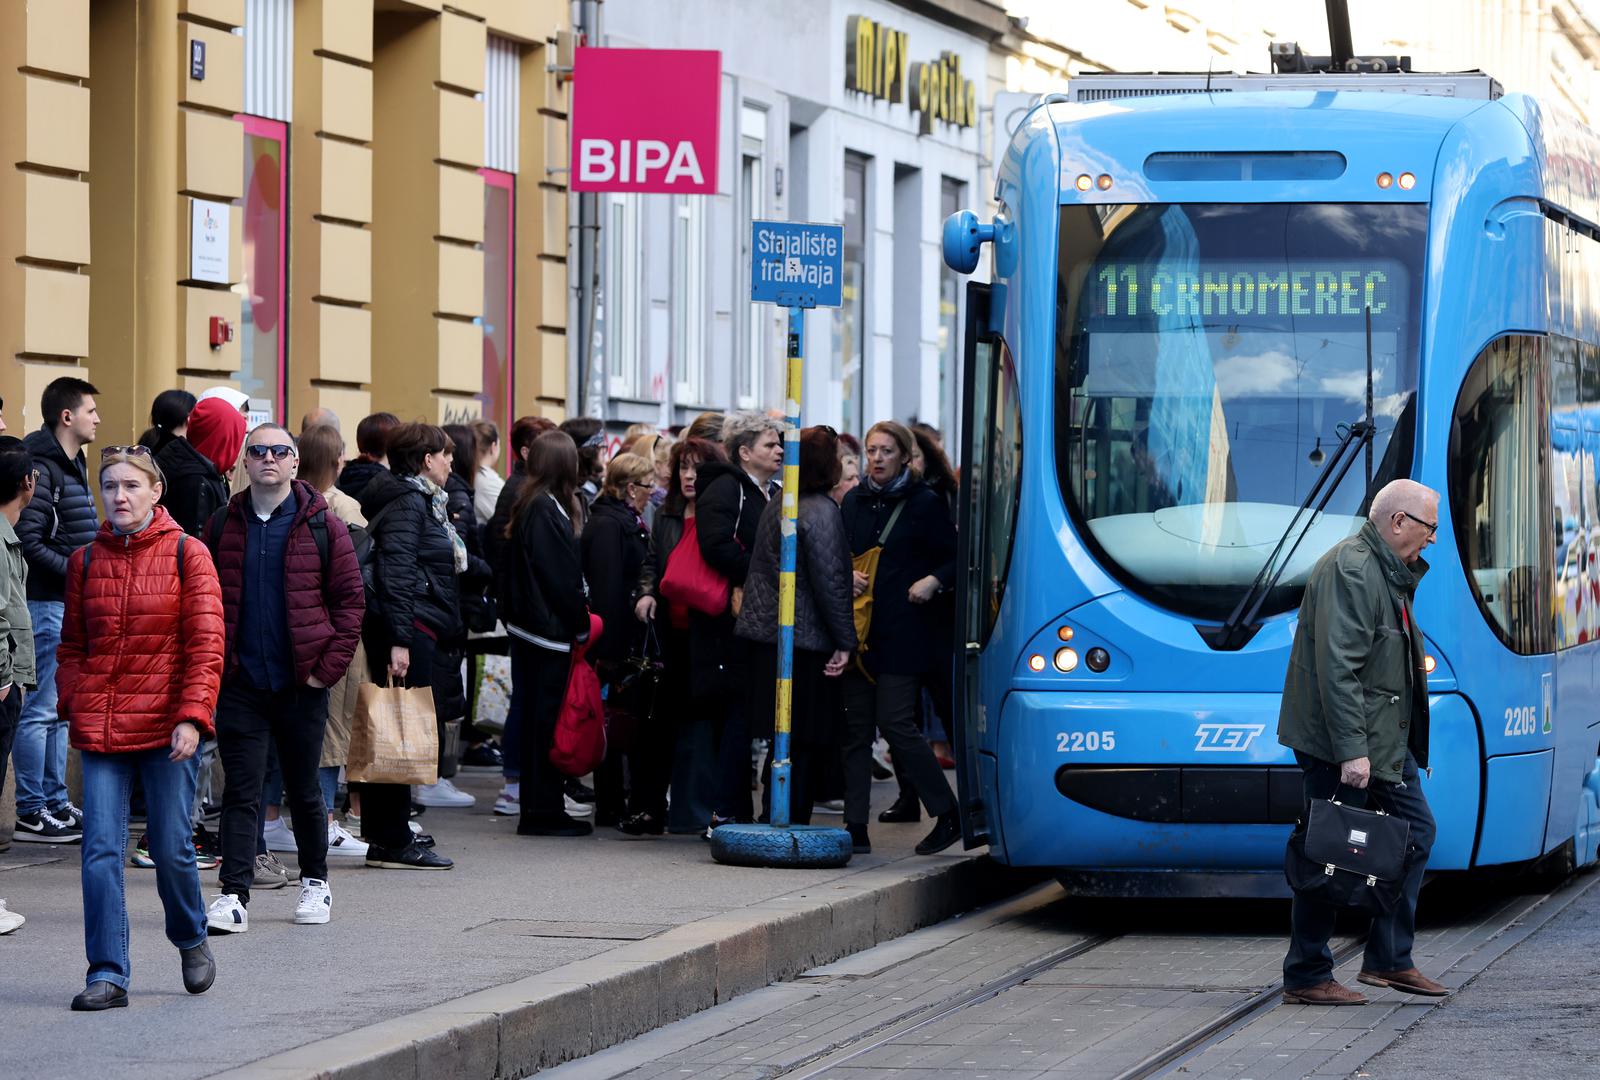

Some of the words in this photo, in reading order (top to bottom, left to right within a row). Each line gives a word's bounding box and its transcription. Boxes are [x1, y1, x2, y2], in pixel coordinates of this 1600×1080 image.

[917, 51, 976, 134] optika
[580, 139, 705, 185] BIPA
[758, 229, 837, 257] Stajalište
[1099, 264, 1137, 315] 11
[1503, 705, 1536, 736] 2205
[1056, 731, 1116, 752] 2205
[1194, 723, 1266, 752] ZET
